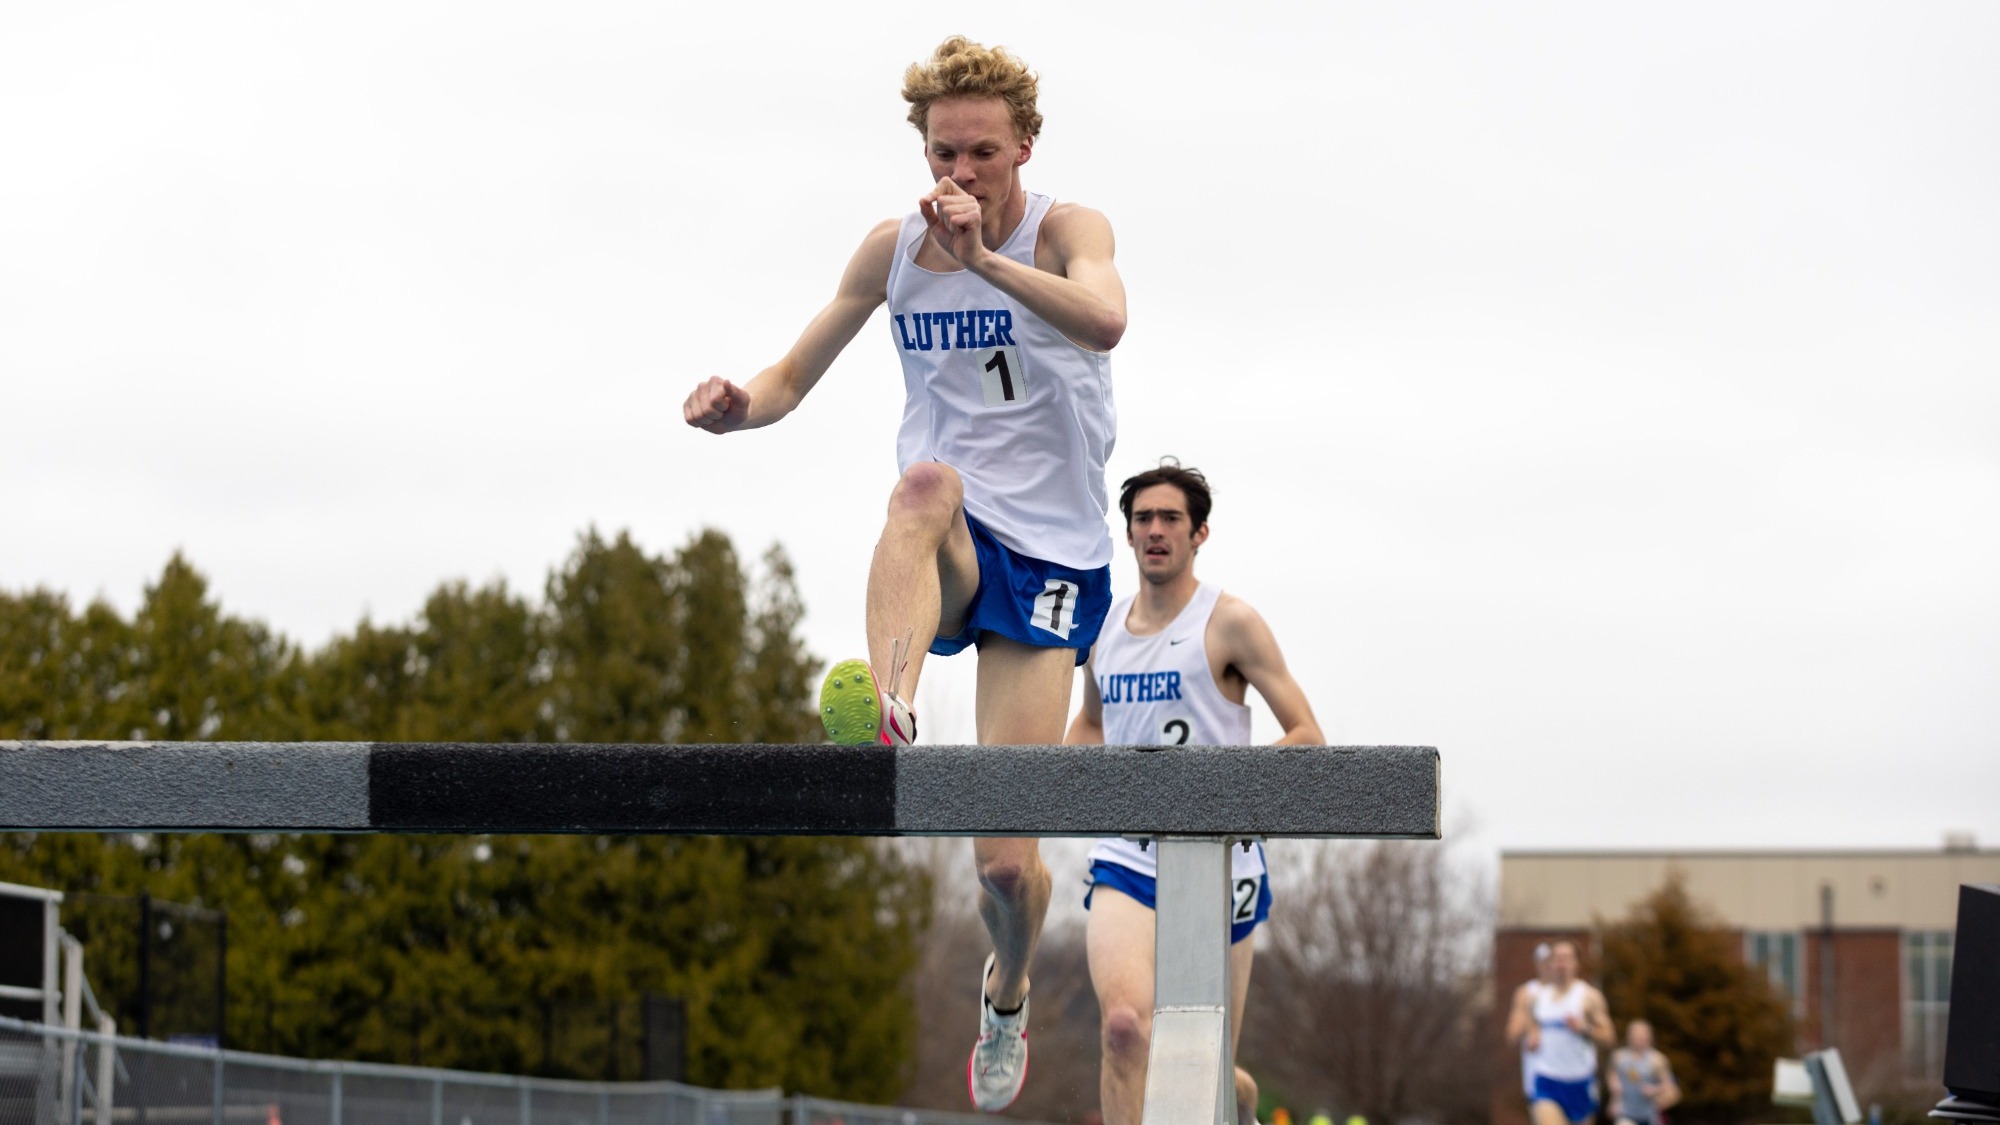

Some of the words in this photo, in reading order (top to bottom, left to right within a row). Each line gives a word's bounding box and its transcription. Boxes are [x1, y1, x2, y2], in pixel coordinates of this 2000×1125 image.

[895, 309, 1016, 351] LUTHER
[984, 350, 1015, 401] 1
[1043, 582, 1069, 631] 1
[1100, 671, 1182, 704] LUTHER
[1163, 719, 1190, 745] 2
[1236, 878, 1257, 920] 2
